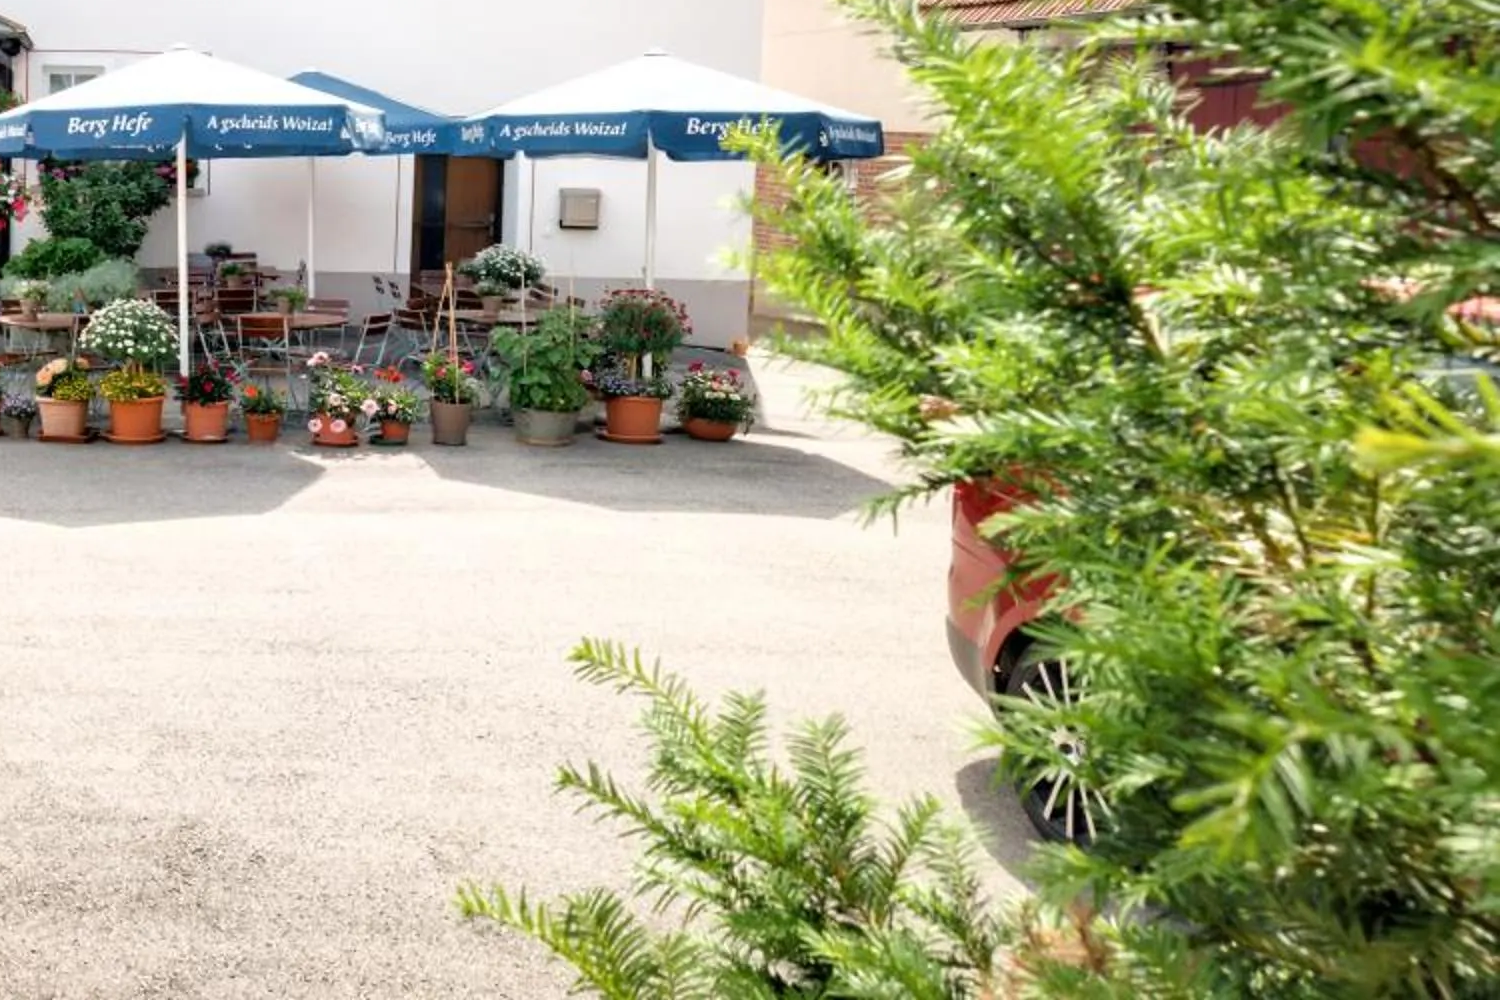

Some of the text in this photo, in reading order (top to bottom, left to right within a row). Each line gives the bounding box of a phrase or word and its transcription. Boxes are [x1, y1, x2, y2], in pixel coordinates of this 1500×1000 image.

[67, 111, 153, 139] Berg Hefe
[207, 115, 218, 129] A
[686, 117, 731, 140] Berg
